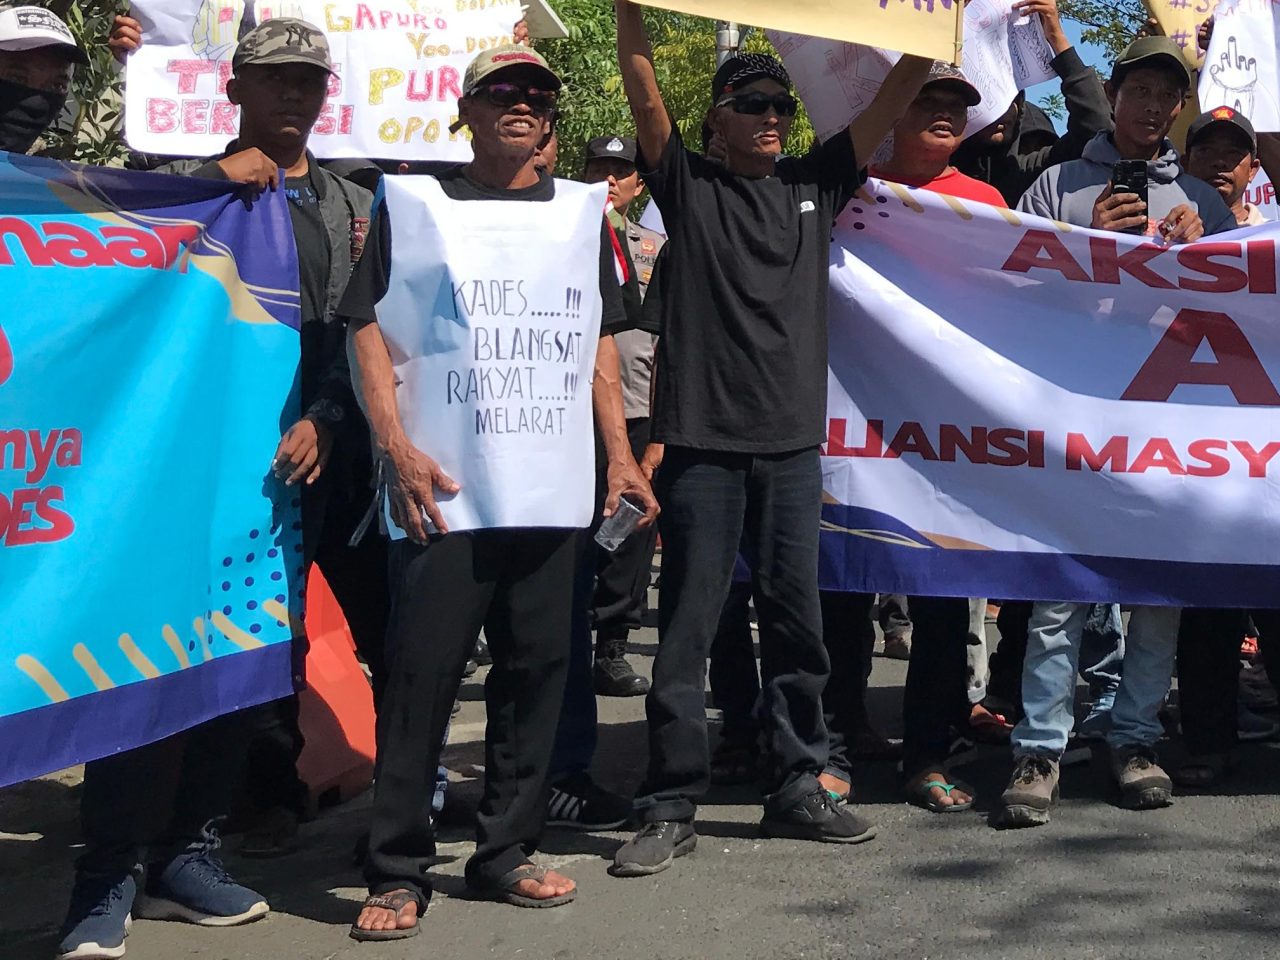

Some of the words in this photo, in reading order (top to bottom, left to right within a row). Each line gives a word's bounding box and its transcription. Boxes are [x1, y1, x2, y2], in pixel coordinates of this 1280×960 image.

[323, 3, 447, 33] GAPURO
[378, 116, 440, 144] OPO
[1003, 229, 1277, 295] AKSI
[474, 327, 582, 364] BLANGSAT
[475, 406, 566, 435] MELARAT
[820, 417, 1045, 468] LIANSI
